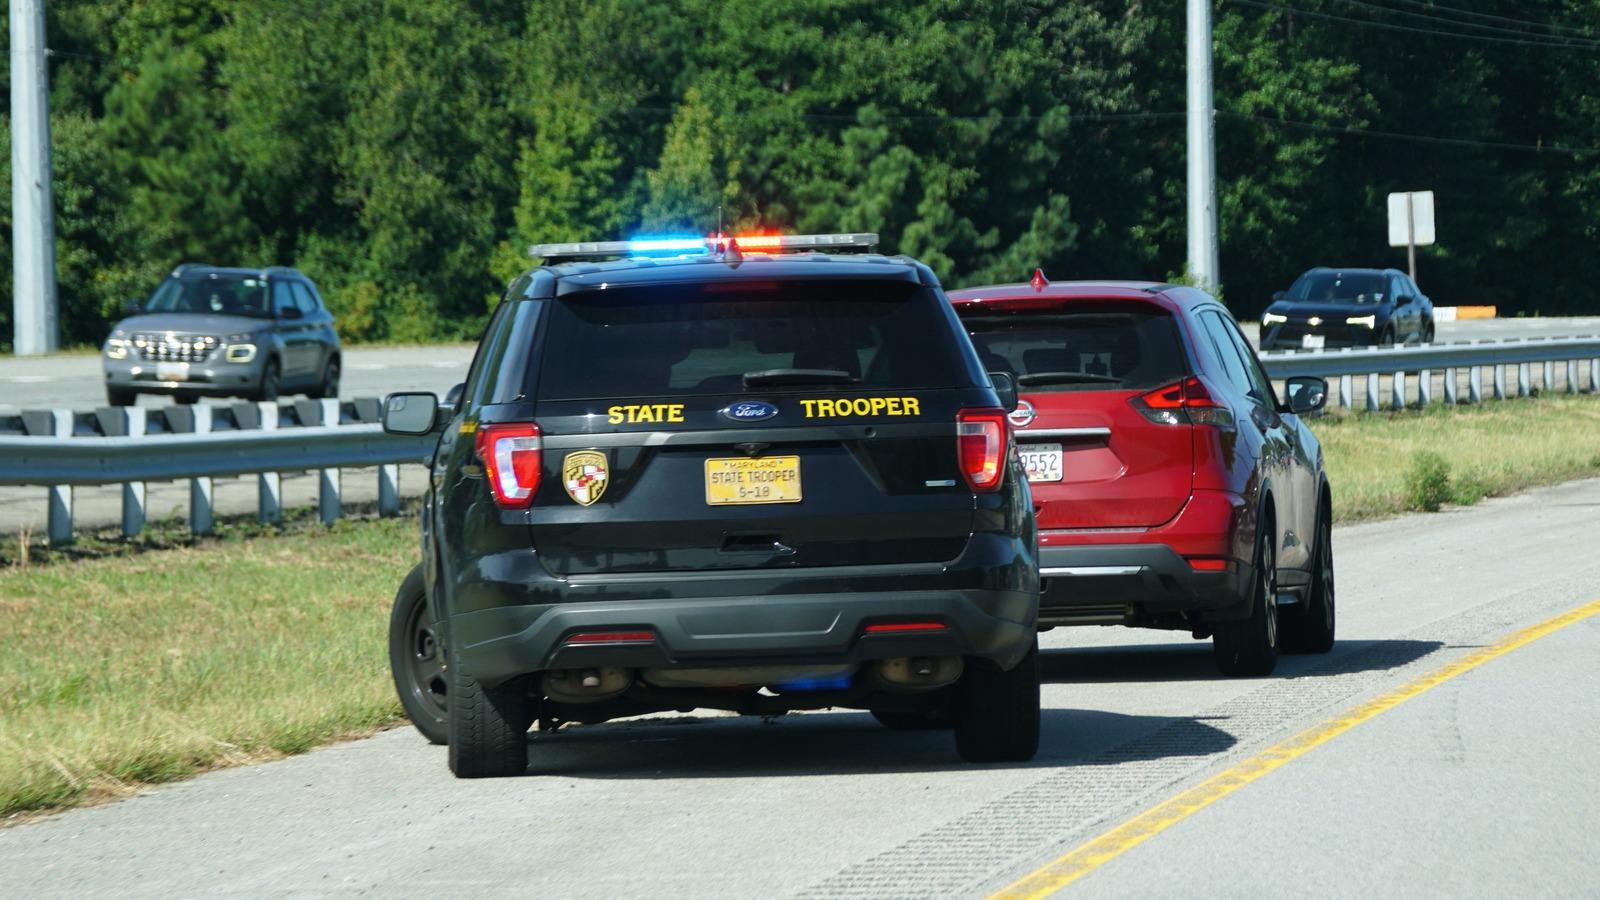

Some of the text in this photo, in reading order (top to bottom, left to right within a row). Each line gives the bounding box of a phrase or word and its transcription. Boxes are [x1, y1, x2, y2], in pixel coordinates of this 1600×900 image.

[608, 397, 920, 424] STATE TROOPER
[735, 404, 766, 417] Ford
[729, 460, 778, 469] MARYLAND
[1020, 453, 1058, 472] 9552
[711, 469, 795, 484] STATE TROOPER
